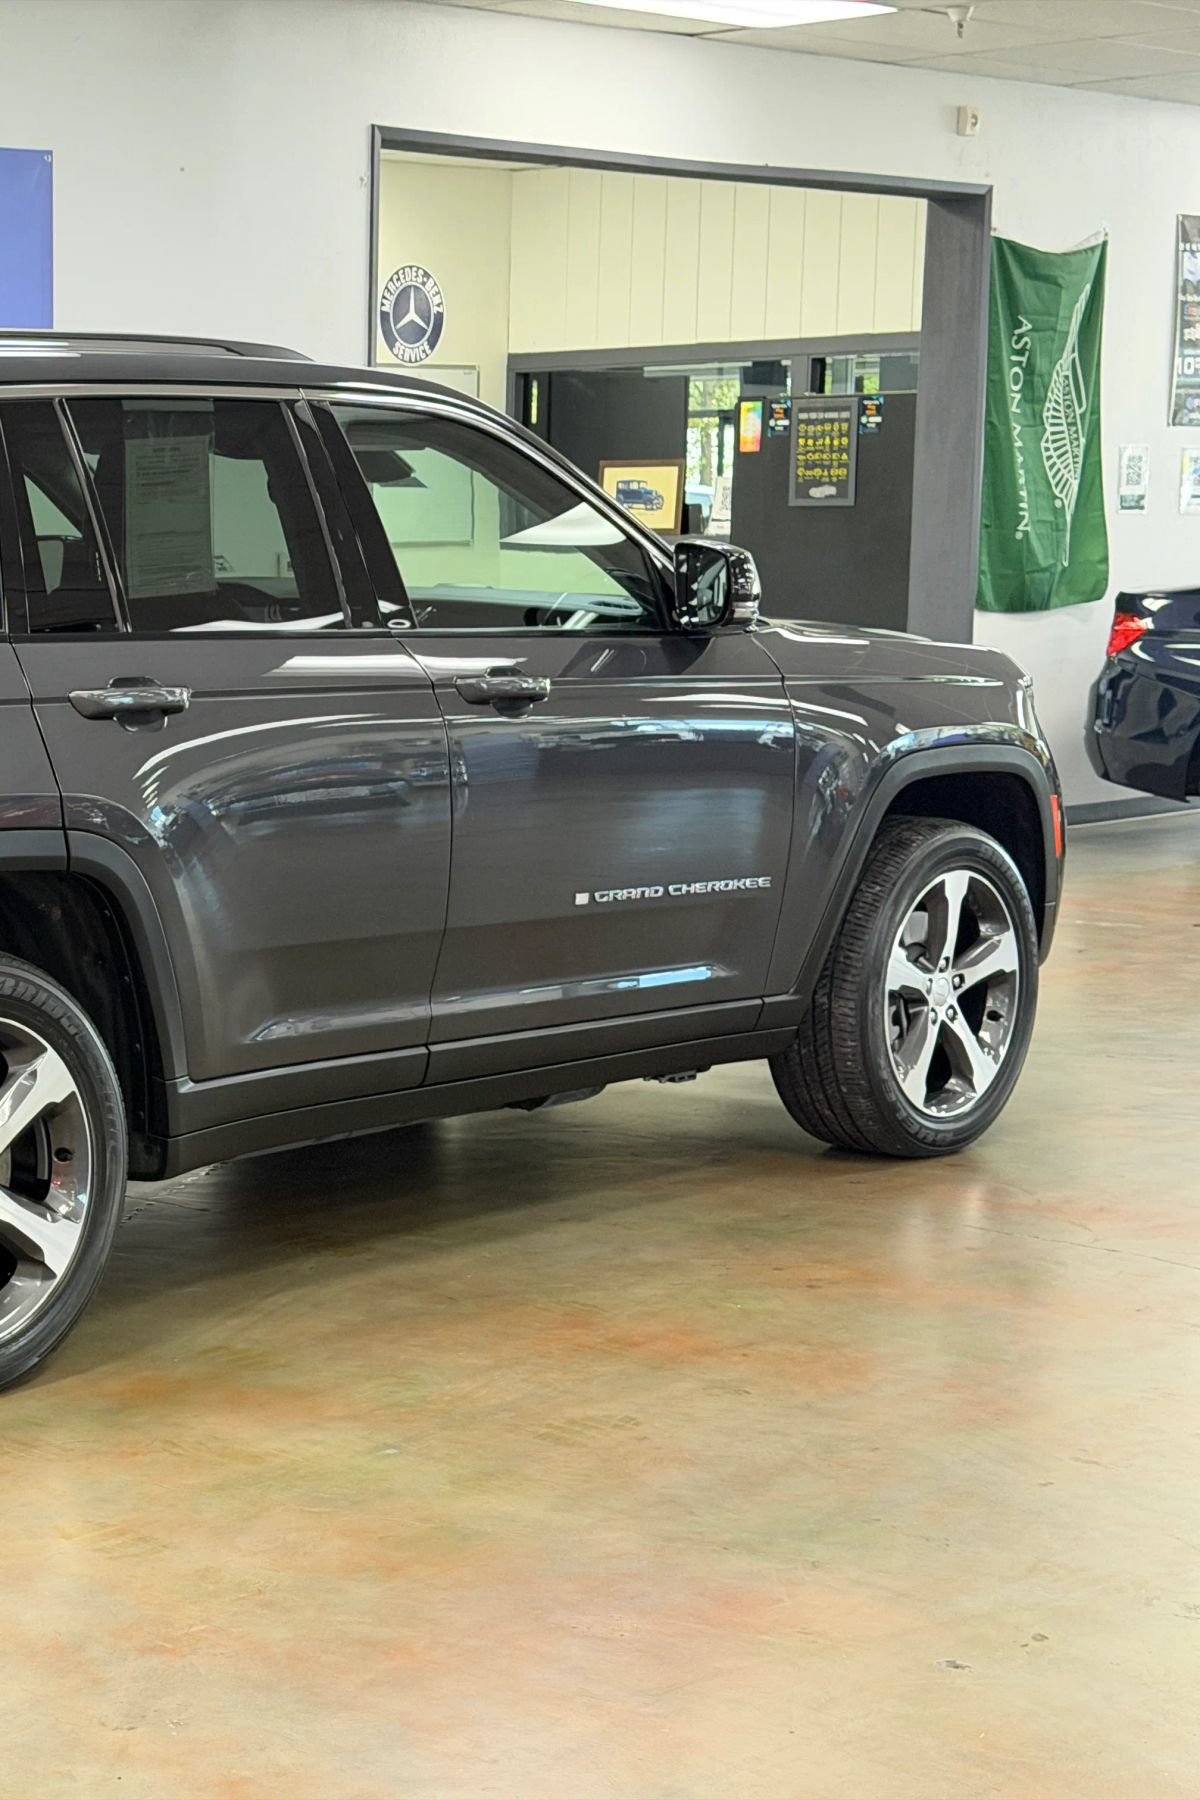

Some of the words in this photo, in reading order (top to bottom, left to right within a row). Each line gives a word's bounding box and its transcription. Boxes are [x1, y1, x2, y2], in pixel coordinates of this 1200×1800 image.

[392, 340, 432, 362] SERVICE
[1009, 315, 1033, 414] ASTON
[594, 885, 664, 902] GRAND
[668, 876, 772, 896] CHEROKEE
